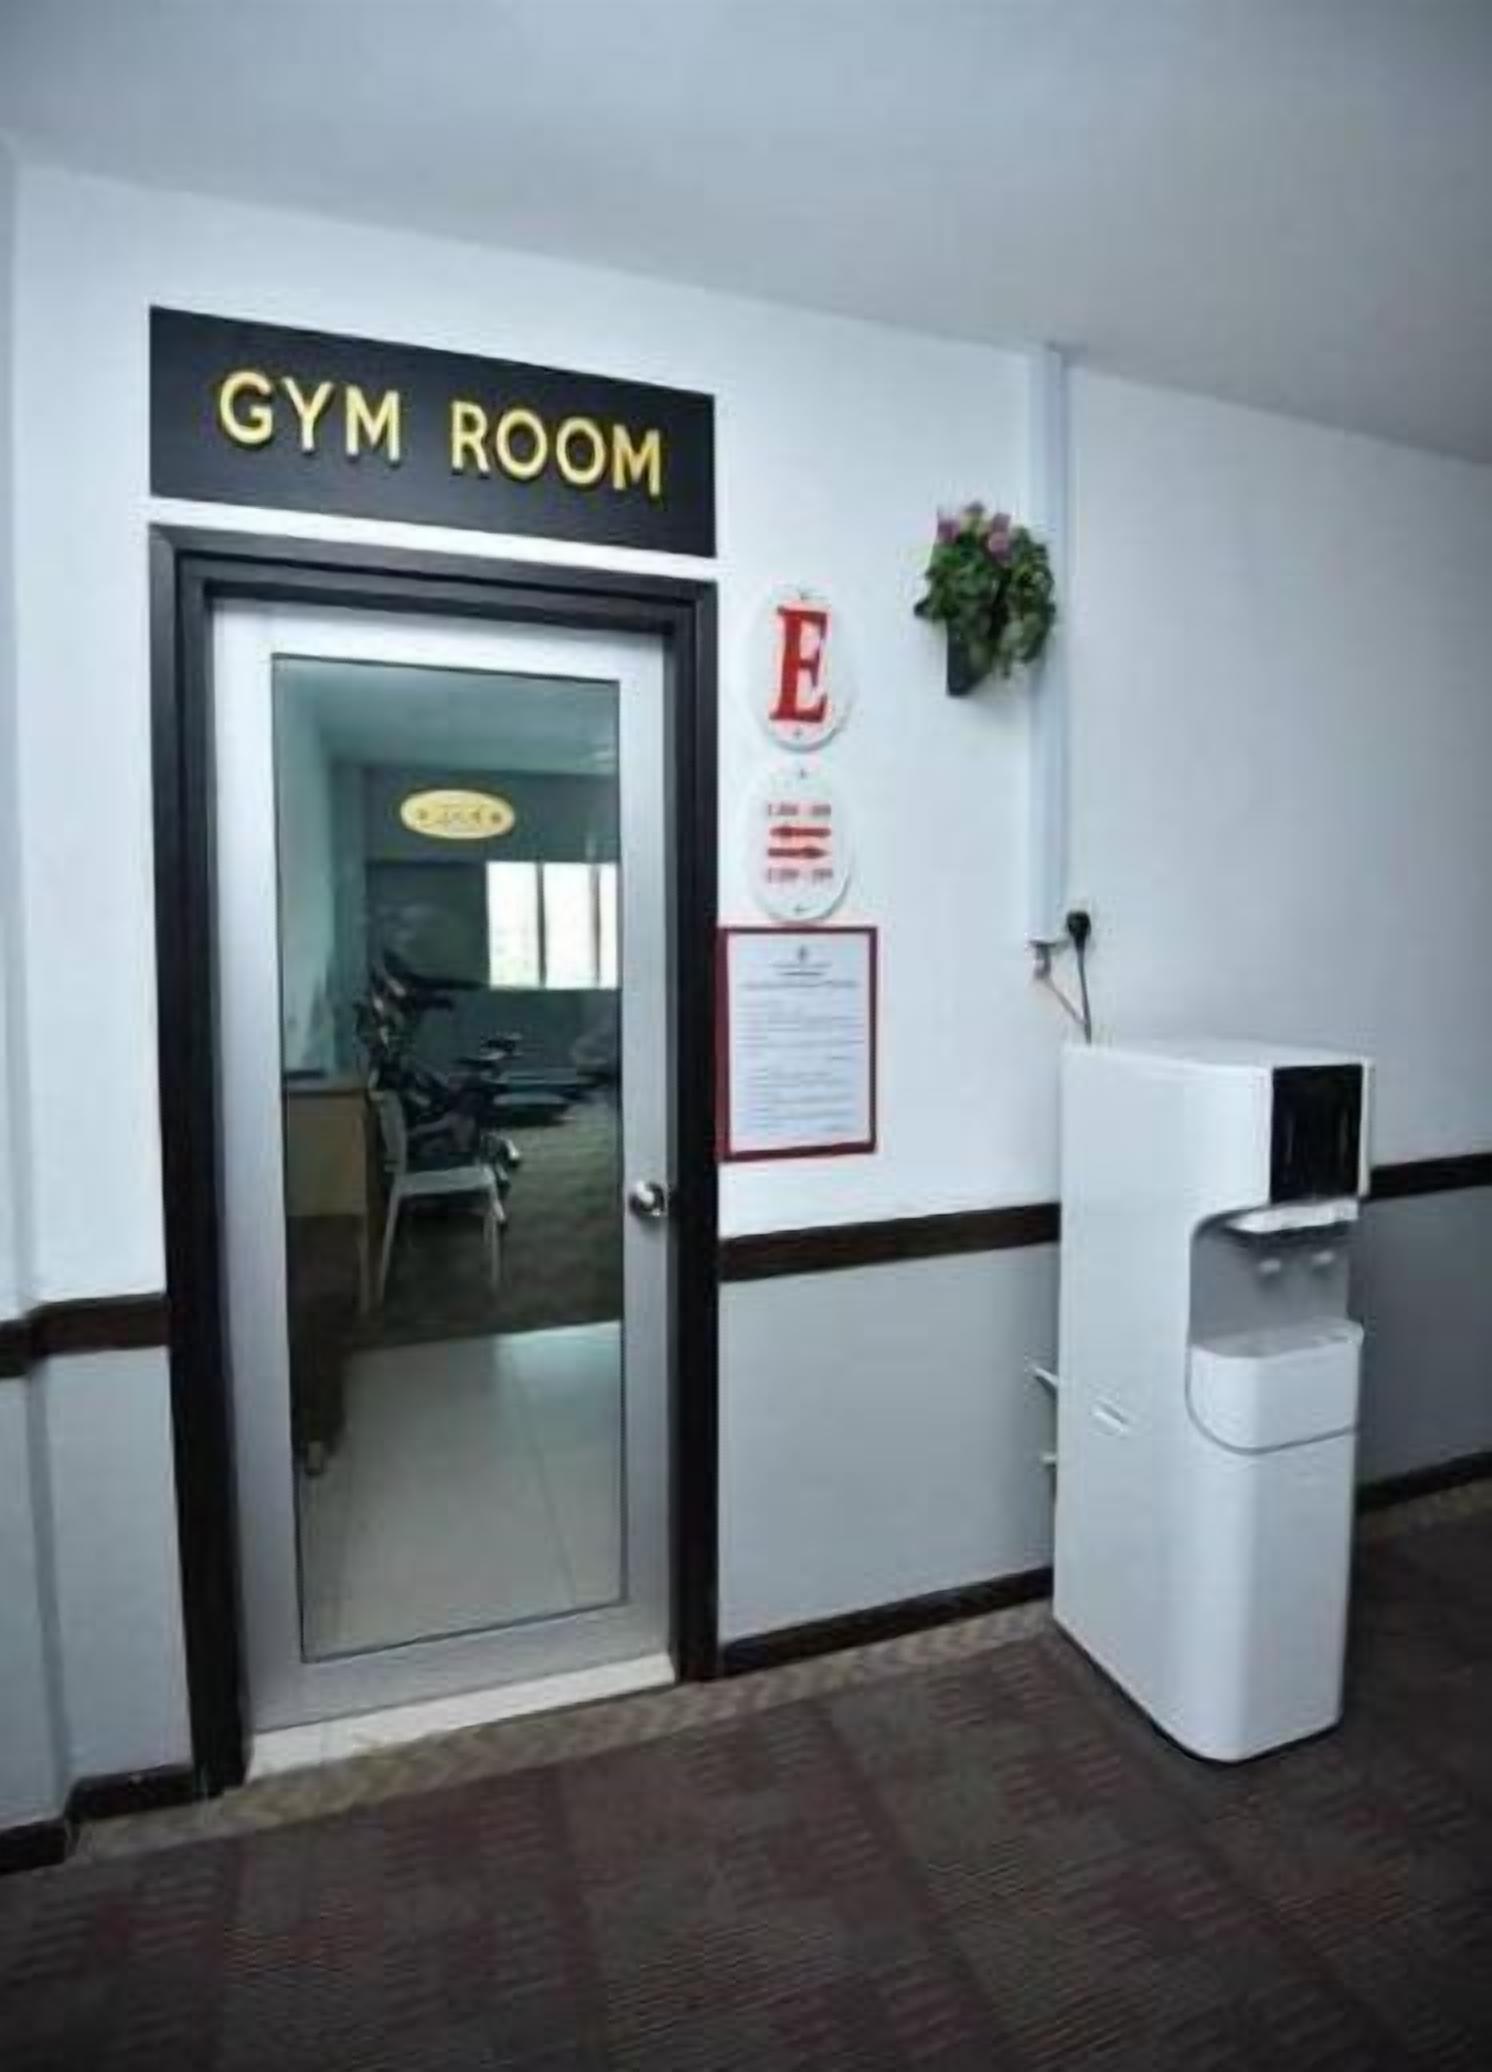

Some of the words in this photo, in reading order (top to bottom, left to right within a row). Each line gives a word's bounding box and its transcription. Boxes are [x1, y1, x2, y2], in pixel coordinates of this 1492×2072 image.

[218, 369, 401, 465] GYM
[449, 400, 662, 496] ROOM
[769, 605, 828, 724] E
